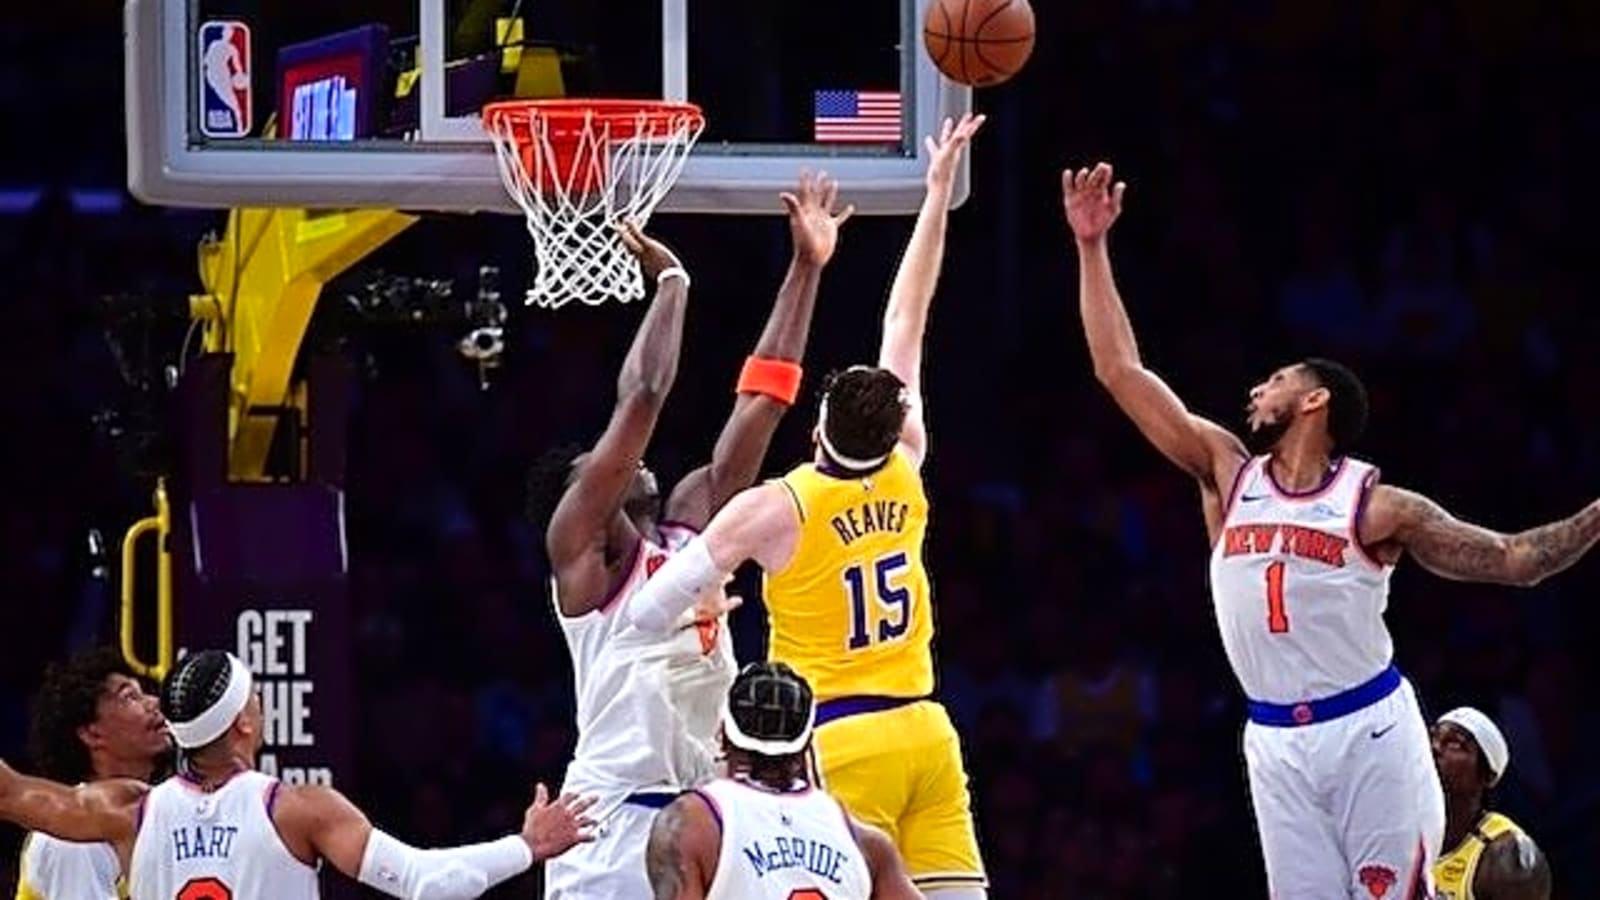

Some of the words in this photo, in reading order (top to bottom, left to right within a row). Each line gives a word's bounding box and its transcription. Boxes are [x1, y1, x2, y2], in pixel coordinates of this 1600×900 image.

[831, 501, 909, 546] REAVES
[1223, 524, 1279, 558] NEW
[1280, 523, 1349, 568] YORK
[843, 551, 911, 651] 15
[1265, 560, 1289, 633] 1
[237, 609, 313, 675] GET
[256, 681, 314, 746] HE
[173, 826, 238, 861] HART
[743, 837, 848, 884] McBRIDE
